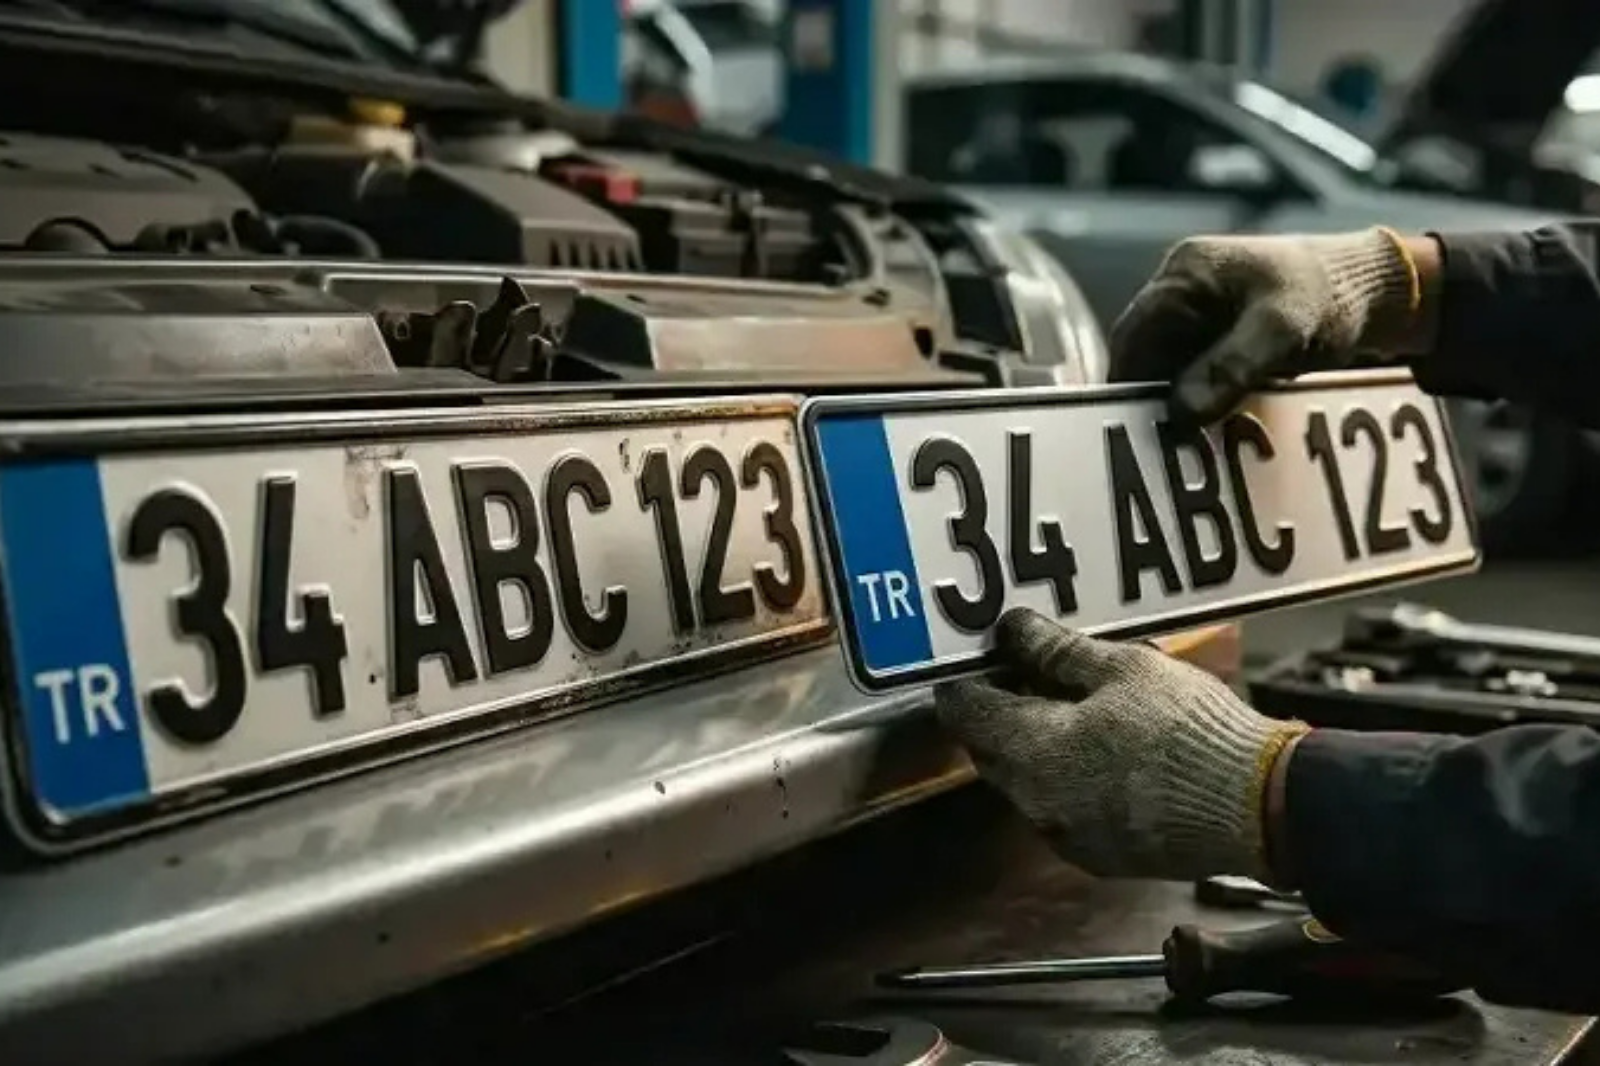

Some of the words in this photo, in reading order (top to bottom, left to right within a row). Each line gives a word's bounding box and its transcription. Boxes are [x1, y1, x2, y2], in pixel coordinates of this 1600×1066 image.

[123, 474, 348, 746] 34
[384, 452, 629, 701] ABC
[637, 441, 804, 635] 123
[909, 428, 1077, 633] 34
[1104, 411, 1295, 603] ABC
[1304, 402, 1453, 562] 123
[857, 570, 916, 623] TR
[35, 662, 125, 744] TR
